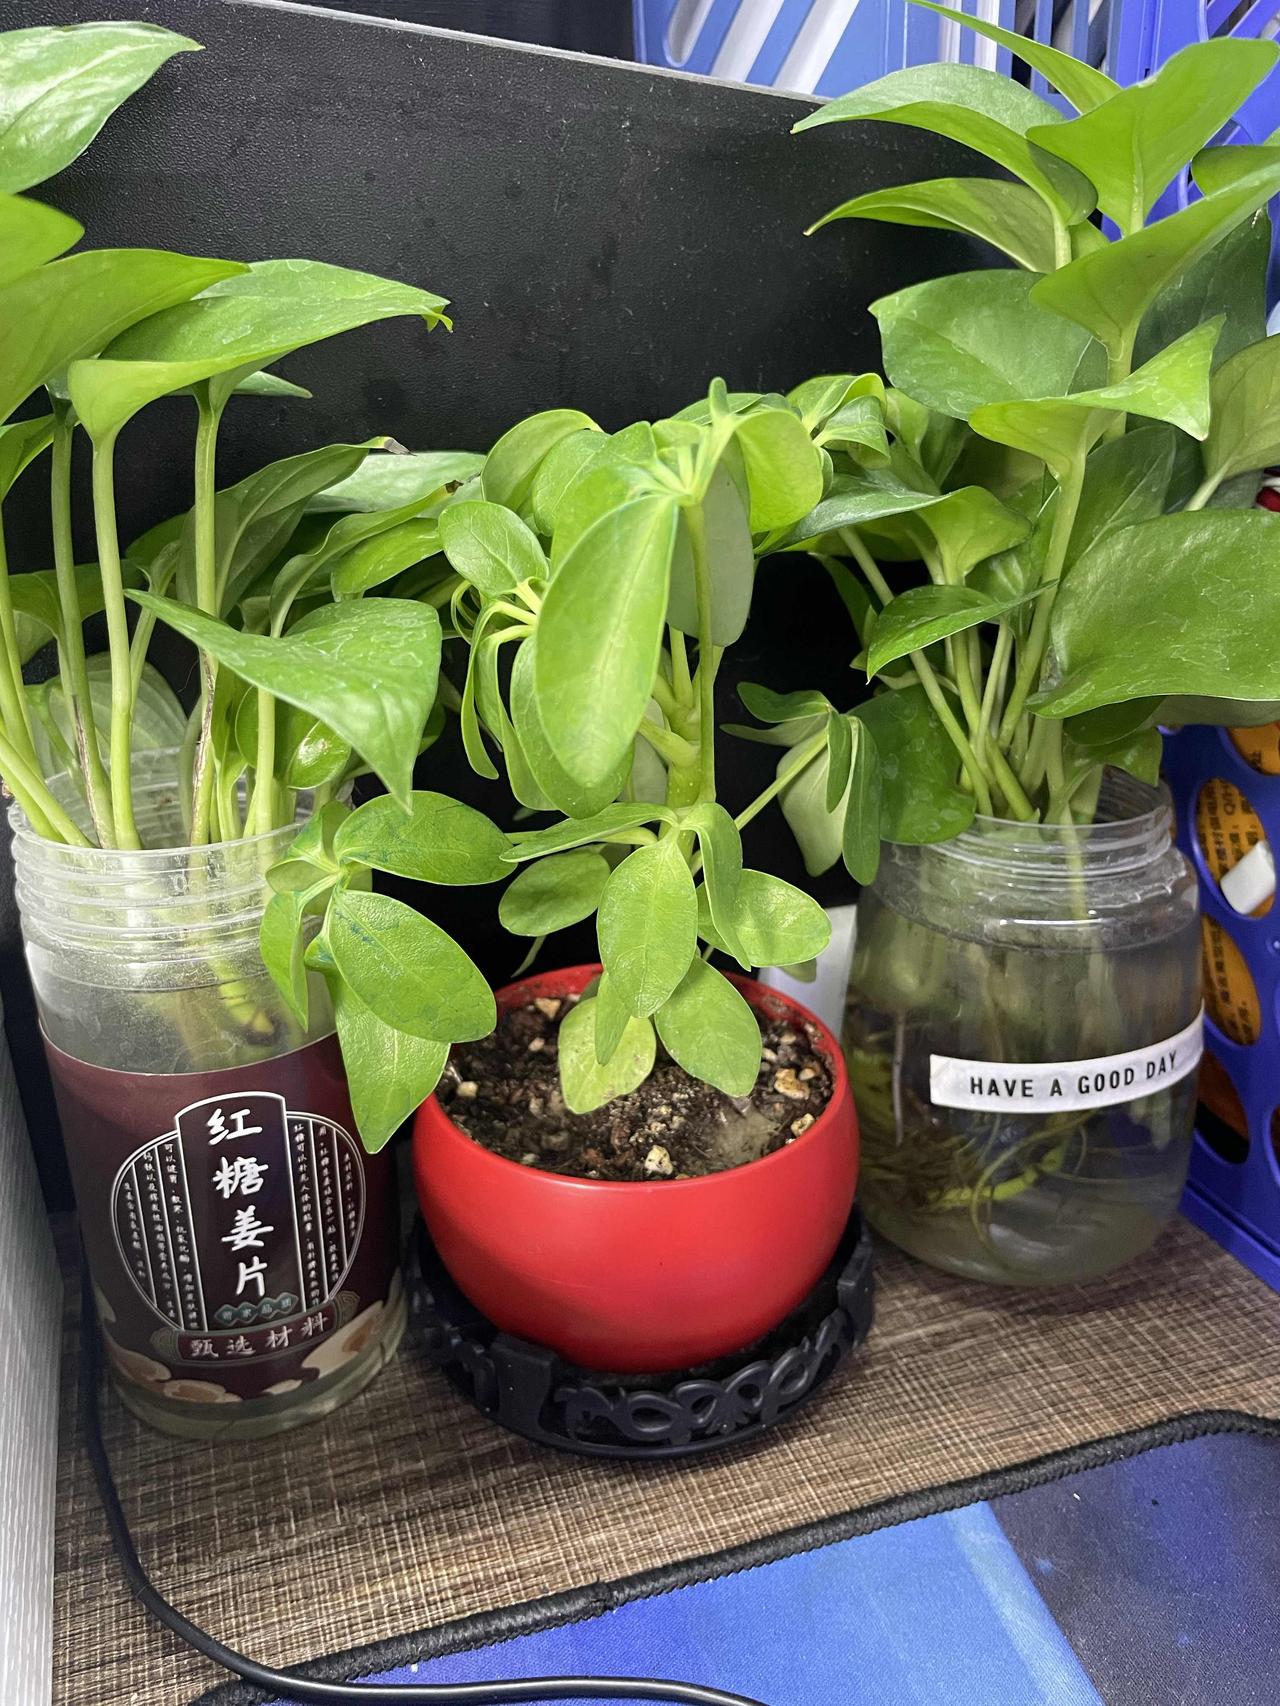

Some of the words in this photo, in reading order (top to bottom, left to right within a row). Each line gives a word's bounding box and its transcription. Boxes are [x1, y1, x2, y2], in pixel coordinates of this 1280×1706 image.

[969, 1076, 1034, 1098] HAVE
[1050, 1078, 1063, 1097] A
[1077, 1067, 1135, 1095] GOOD
[1146, 1049, 1178, 1080] DAY
[206, 1107, 275, 1298] 红糖姜片
